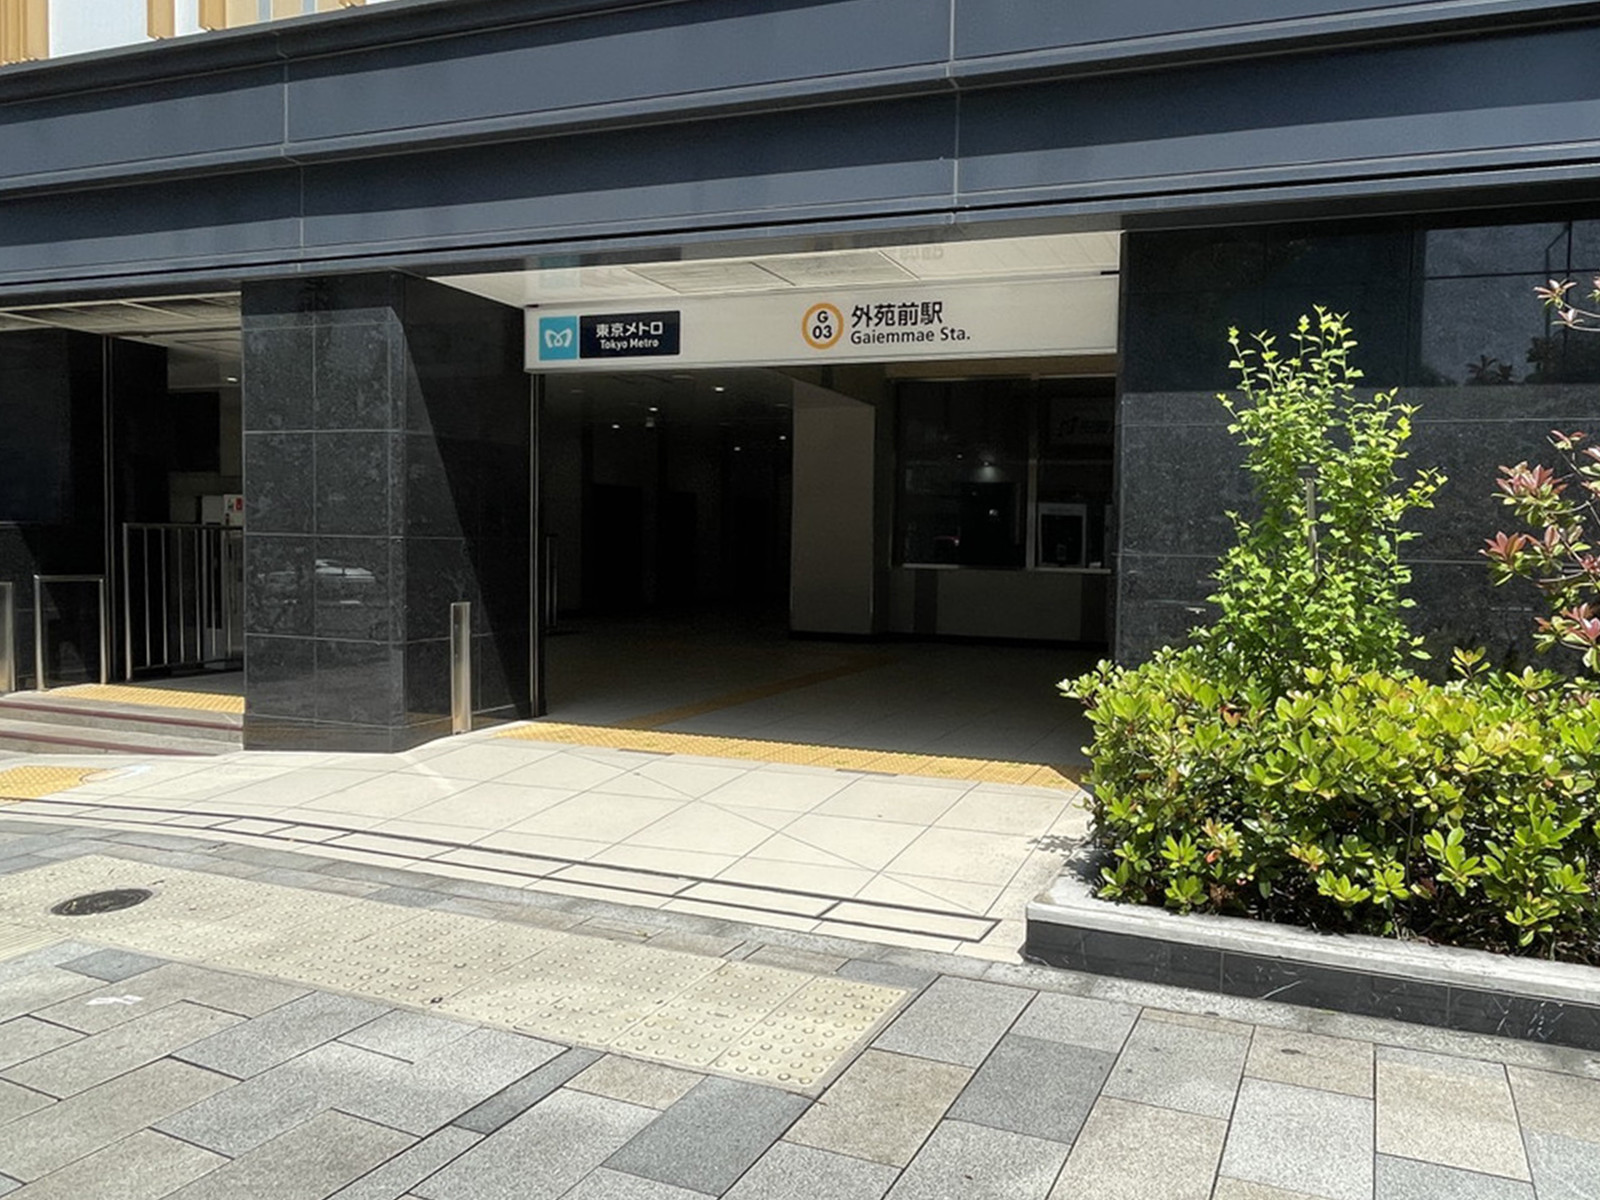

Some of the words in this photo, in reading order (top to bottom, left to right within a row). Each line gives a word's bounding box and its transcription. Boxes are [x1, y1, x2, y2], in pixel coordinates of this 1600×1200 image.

[817, 310, 829, 323] G
[851, 301, 943, 328] 外苑前駅
[596, 321, 663, 338] 東京メトロ
[812, 325, 833, 339] 03
[850, 329, 935, 345] Gaiemmae
[940, 326, 971, 341] Sta.
[600, 340, 628, 350] Tokyo
[629, 338, 659, 348] Metro
